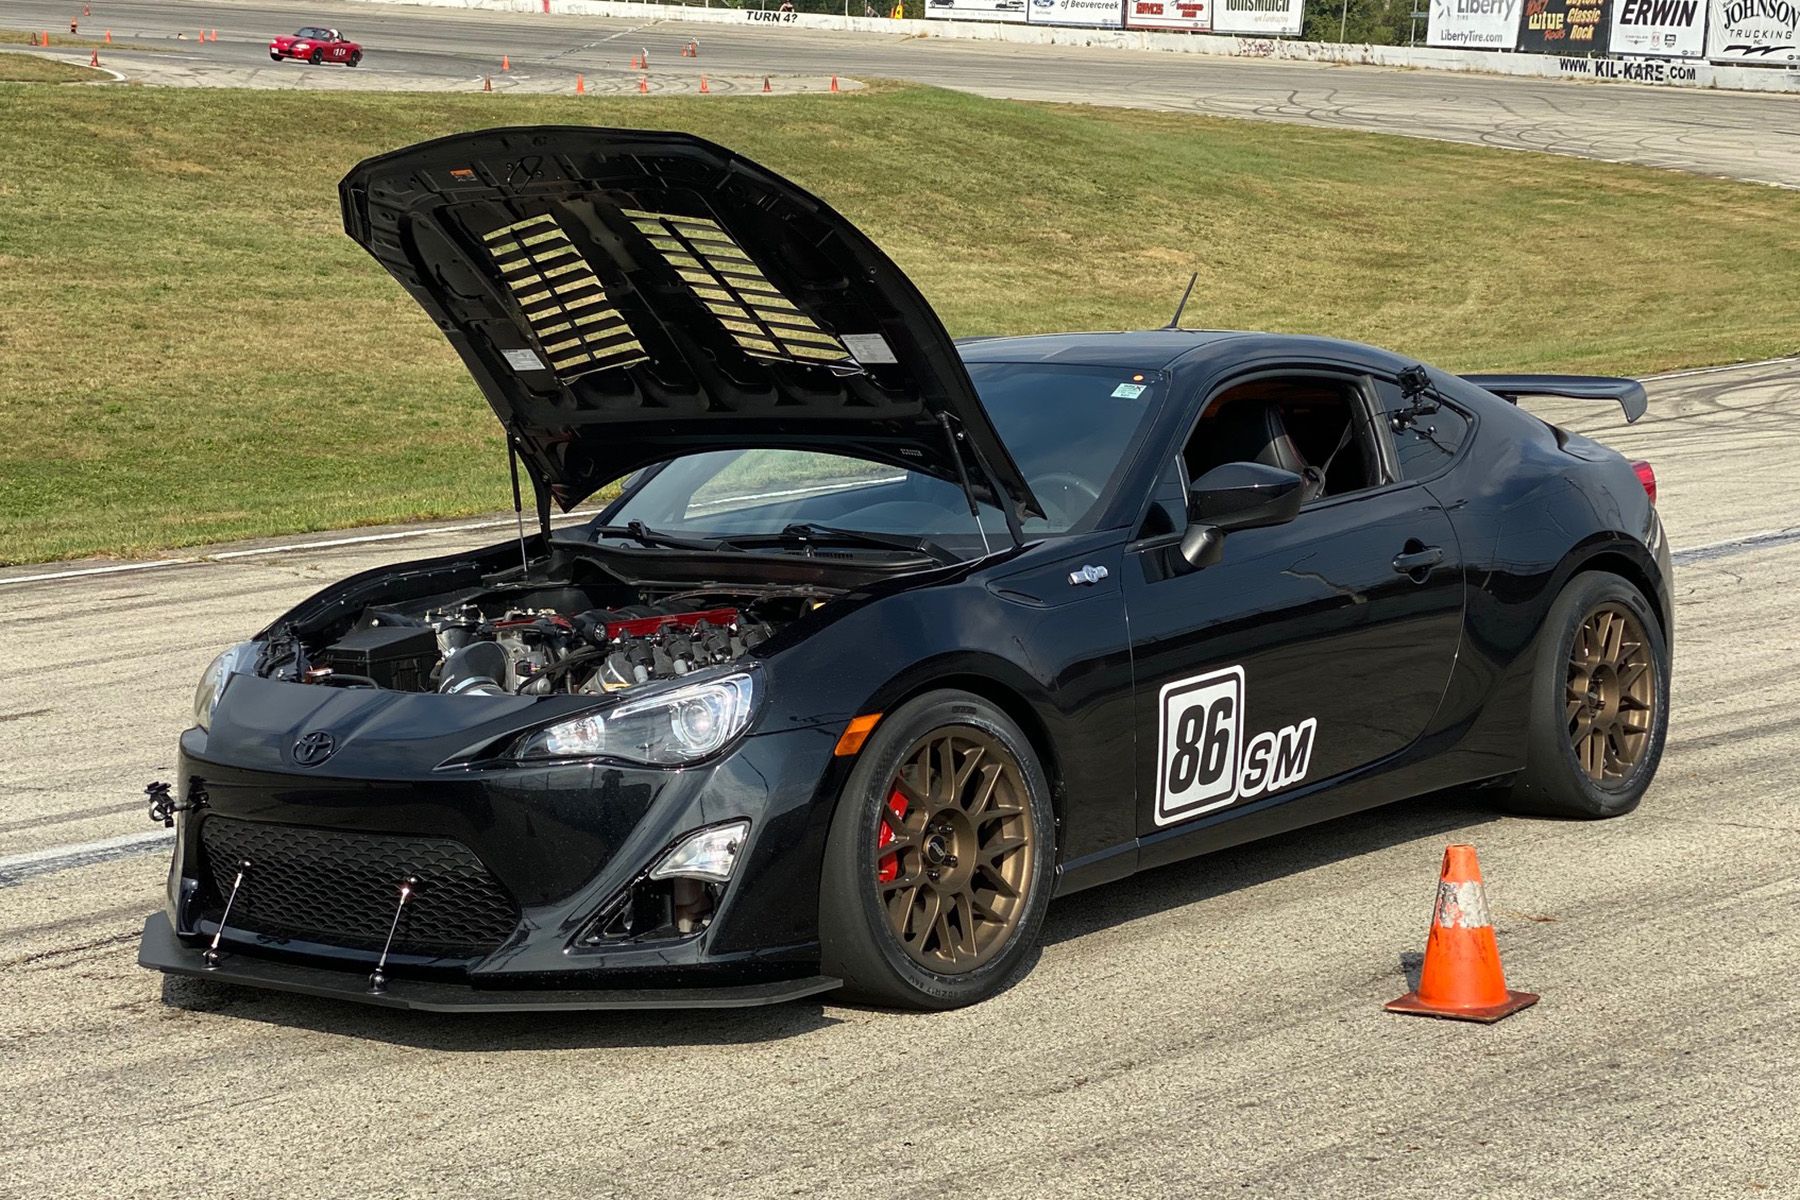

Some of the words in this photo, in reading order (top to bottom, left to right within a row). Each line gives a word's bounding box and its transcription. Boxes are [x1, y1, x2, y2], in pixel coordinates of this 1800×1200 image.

[1070, 0, 1119, 9] Beavercreek
[1457, 0, 1516, 21] Liberty
[1619, 0, 1698, 27] ERWIN
[746, 11, 780, 23] TURN
[783, 14, 798, 23] 4?
[1567, 8, 1601, 24] Classic
[1724, 0, 1800, 32] JOHNSON
[1440, 29, 1503, 44] LibertyTire.com
[1569, 25, 1595, 40] Rock
[1729, 29, 1793, 39] TRUCKING
[1595, 61, 1664, 81] KIL-KARE
[1168, 696, 1234, 795] 86
[1242, 722, 1315, 793] SM
